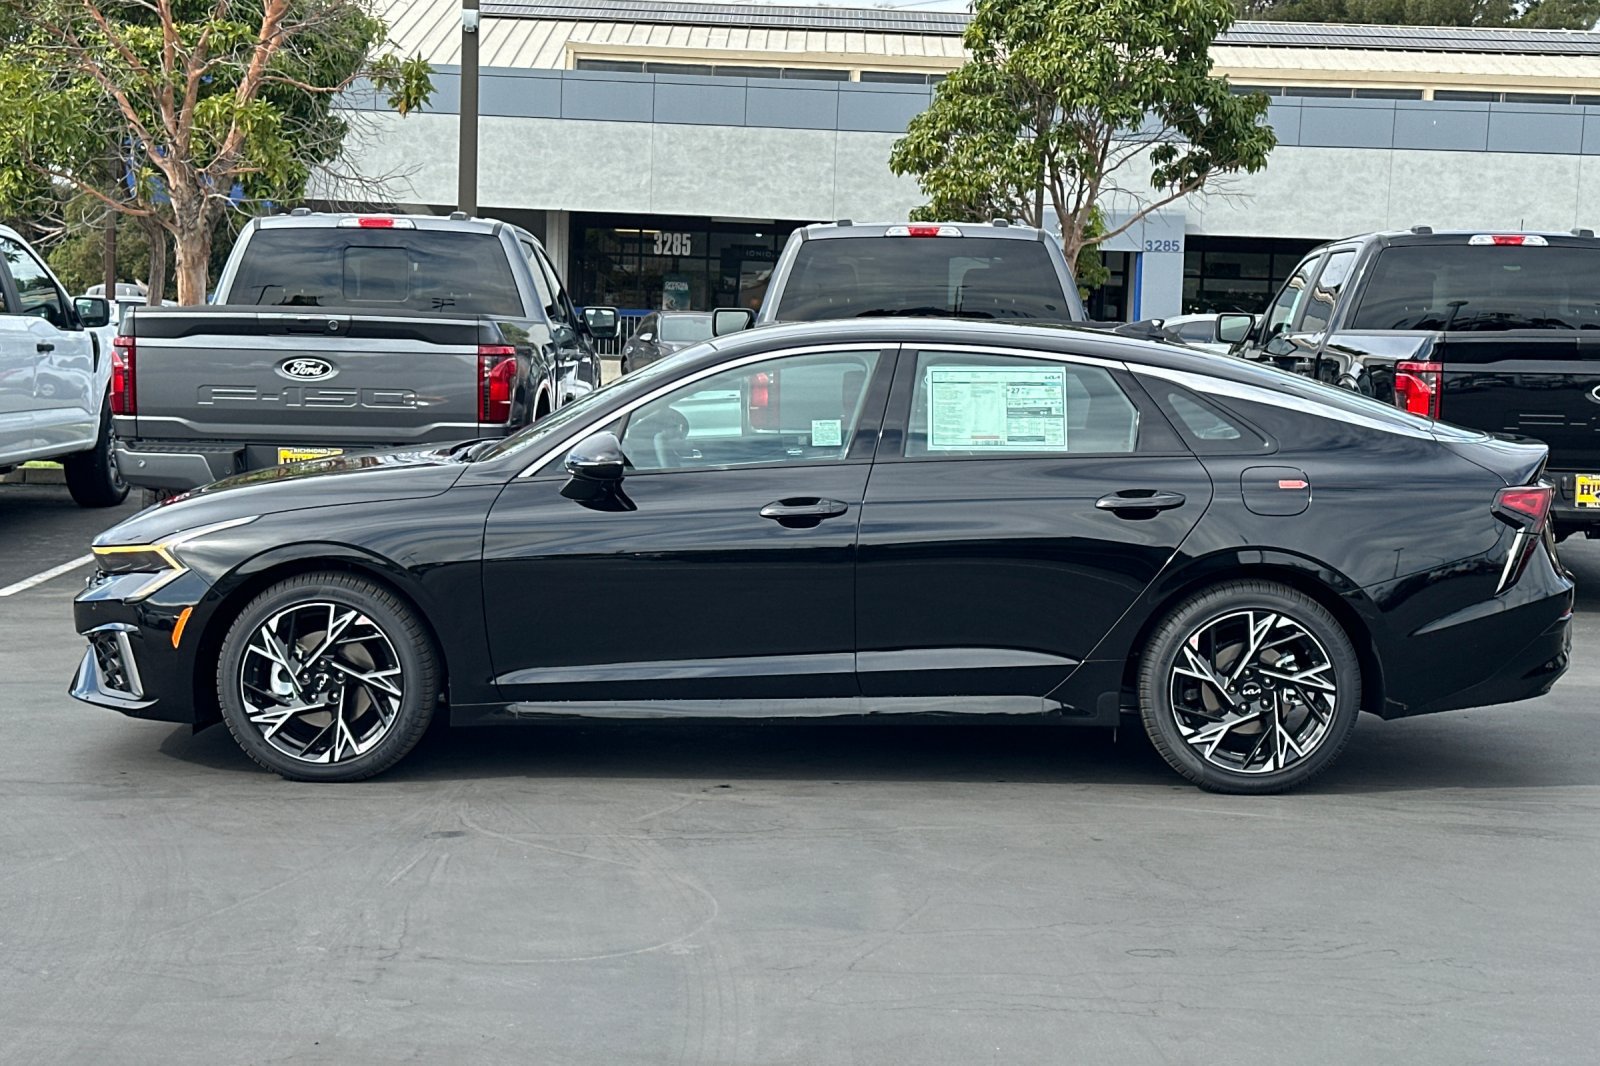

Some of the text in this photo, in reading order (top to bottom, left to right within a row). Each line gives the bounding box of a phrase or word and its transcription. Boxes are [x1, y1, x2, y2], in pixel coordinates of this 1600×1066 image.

[653, 232, 691, 256] 3285
[1145, 240, 1180, 252] 3285
[290, 360, 323, 376] Ford
[197, 384, 417, 409] F-150
